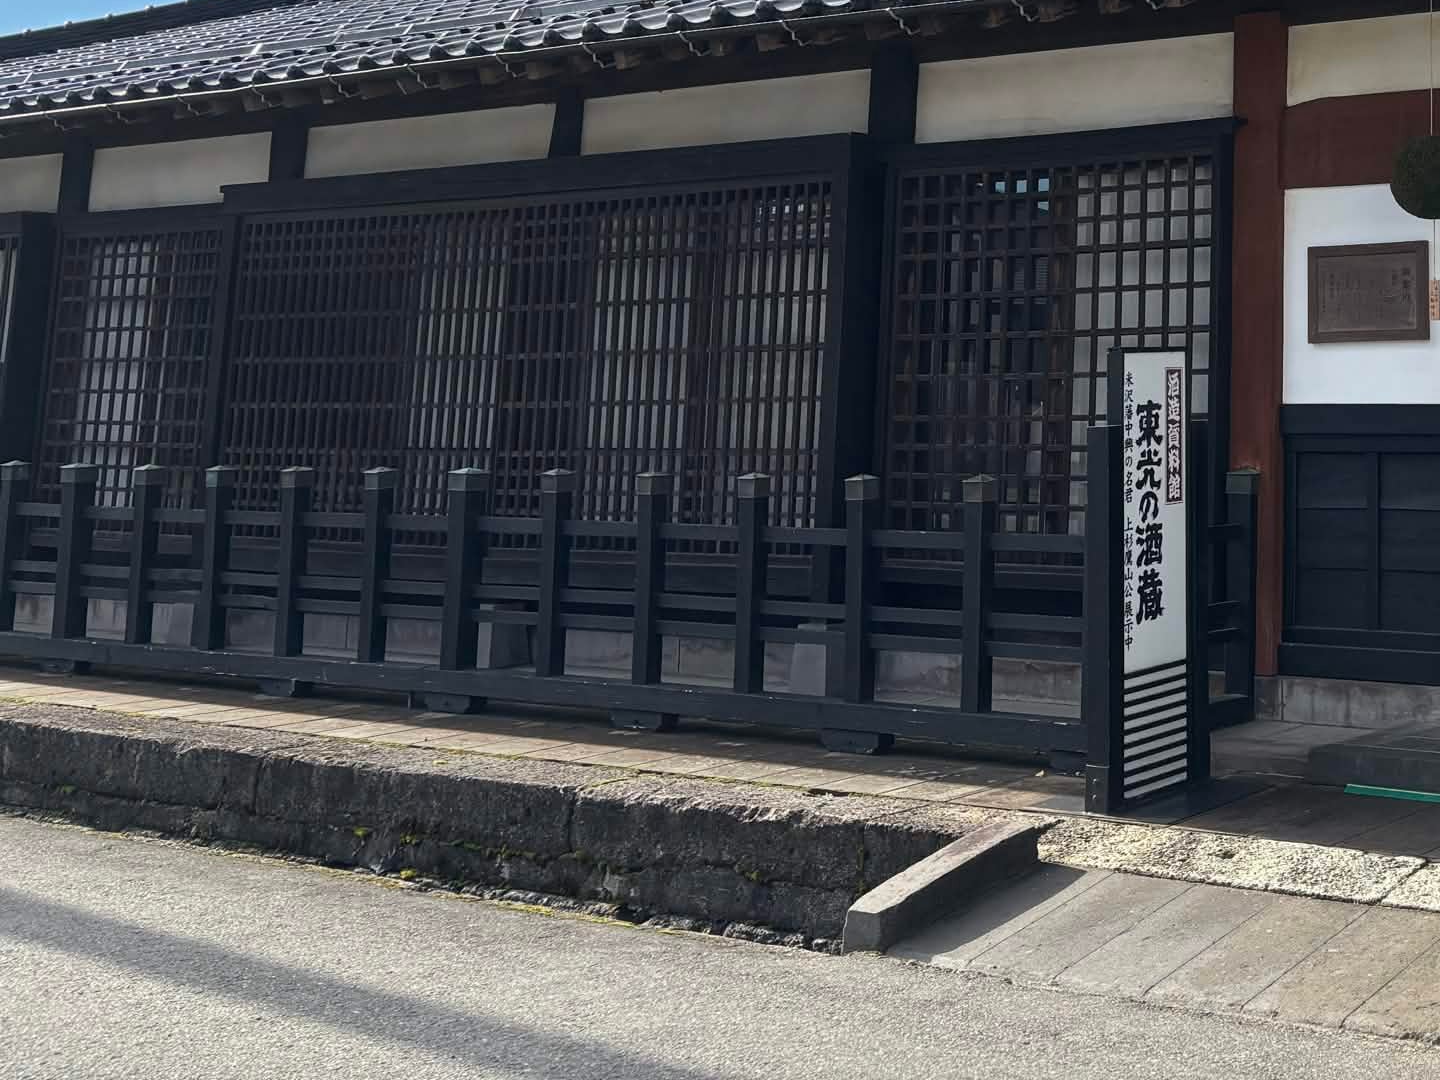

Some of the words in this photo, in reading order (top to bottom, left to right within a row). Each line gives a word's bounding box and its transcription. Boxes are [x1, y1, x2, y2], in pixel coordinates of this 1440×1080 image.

[1135, 399, 1165, 625] 東光の酒蔵
[1167, 371, 1182, 500] 酒造資料館
